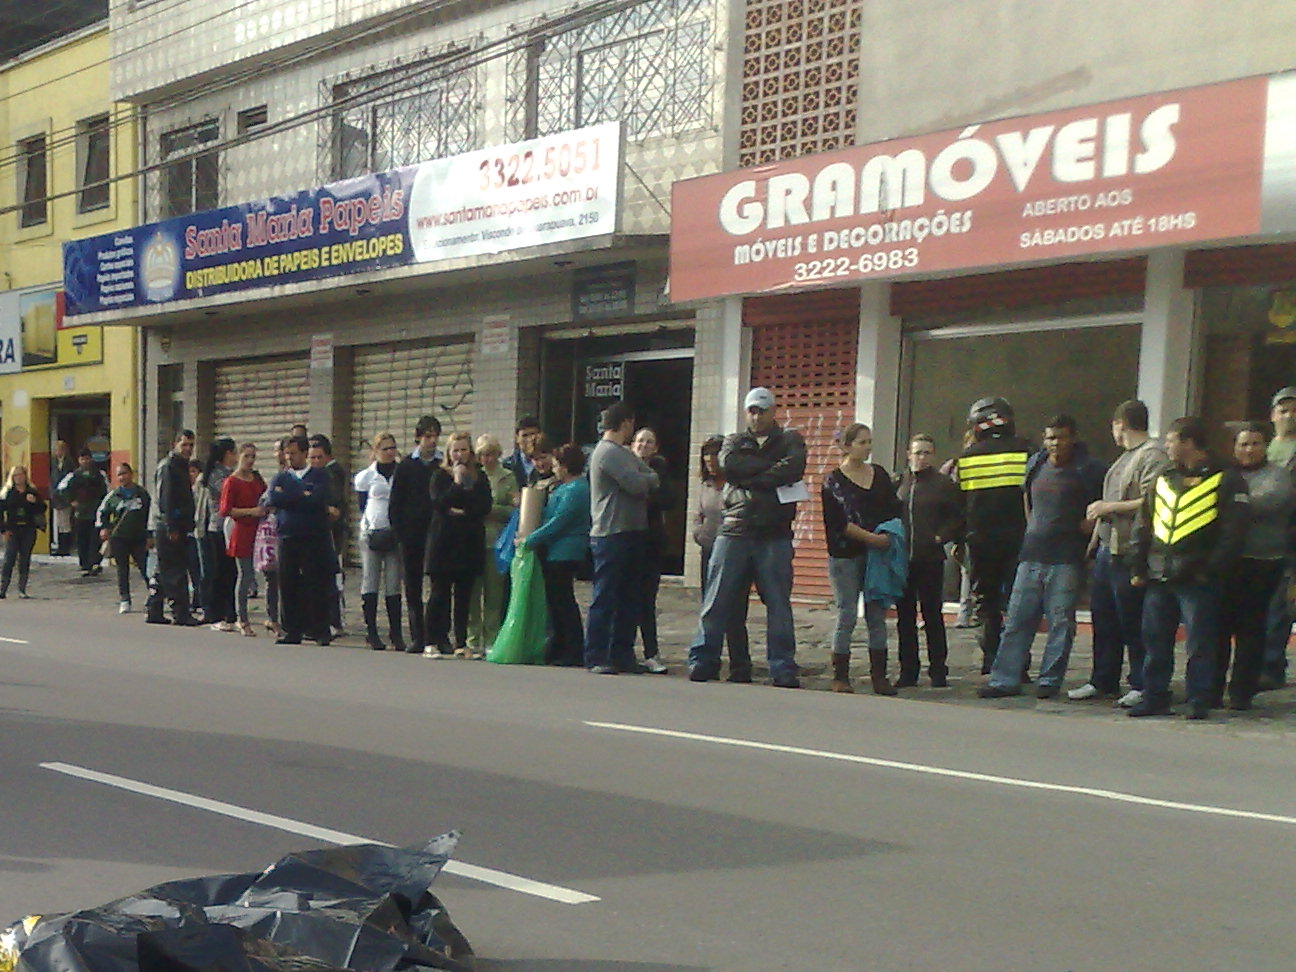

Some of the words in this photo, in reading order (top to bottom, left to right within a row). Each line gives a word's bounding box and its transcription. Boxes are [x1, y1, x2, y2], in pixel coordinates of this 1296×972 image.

[479, 137, 601, 191] 3322.5051
[718, 102, 1180, 235] GRAMÓVEIS
[184, 219, 242, 259] Santa
[246, 204, 314, 247] Maria
[319, 185, 404, 236] Papeis
[1022, 194, 1091, 217] ABERTO
[1095, 189, 1133, 208] AOS
[734, 236, 801, 265] MÓVEIS
[807, 234, 817, 253] E
[823, 209, 972, 252] DECORAÇÕES
[1019, 223, 1105, 248] SÁBADOS
[1109, 215, 1143, 237] ATÉ
[1147, 212, 1198, 232] 18HS
[185, 258, 262, 290] DISTRIBUIDORA
[264, 256, 279, 276] DE
[280, 250, 320, 274] PAPEIS
[321, 245, 330, 266] E
[331, 233, 404, 265] ENVELOPES
[794, 248, 919, 280] 3222-6983
[585, 362, 621, 380] Santa
[585, 381, 621, 397] Maria
